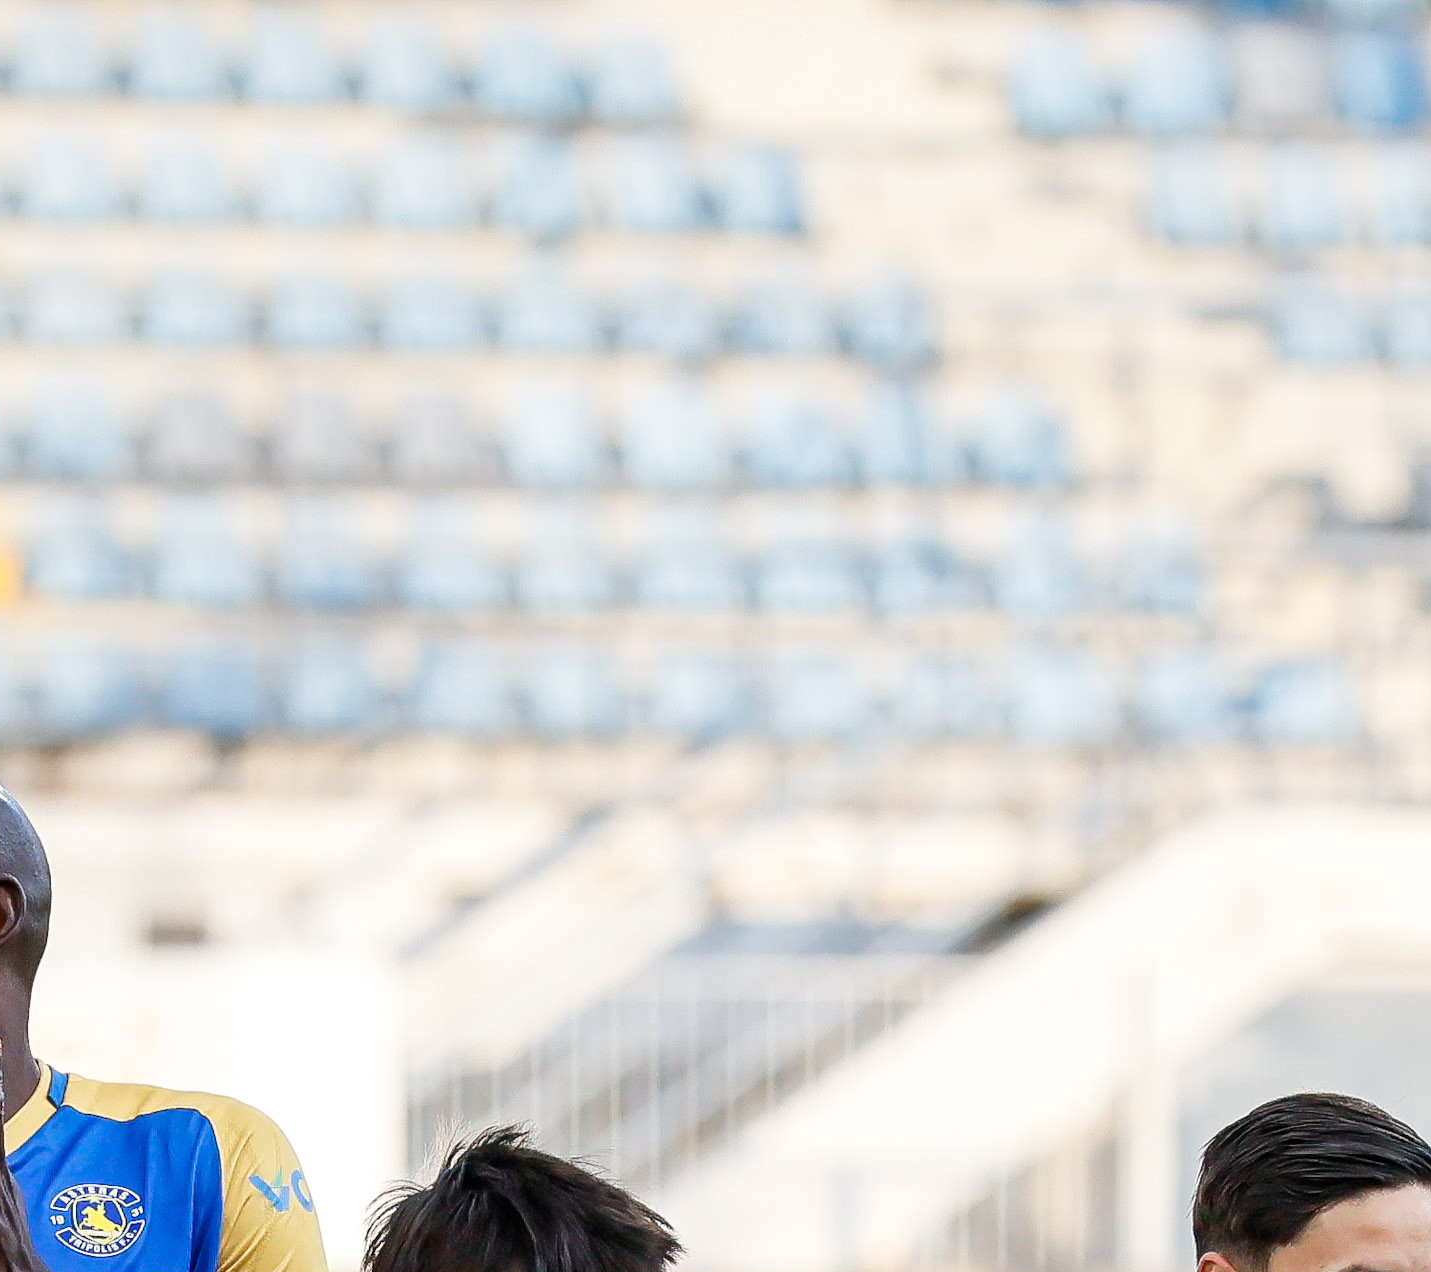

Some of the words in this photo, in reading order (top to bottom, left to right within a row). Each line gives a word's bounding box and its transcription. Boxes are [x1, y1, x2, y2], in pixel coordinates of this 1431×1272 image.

[59, 1186, 129, 1204] ASTERAS
[49, 1214, 65, 1225] 19
[130, 1205, 144, 1218] 31
[68, 1235, 119, 1253] TRIPOLIS
